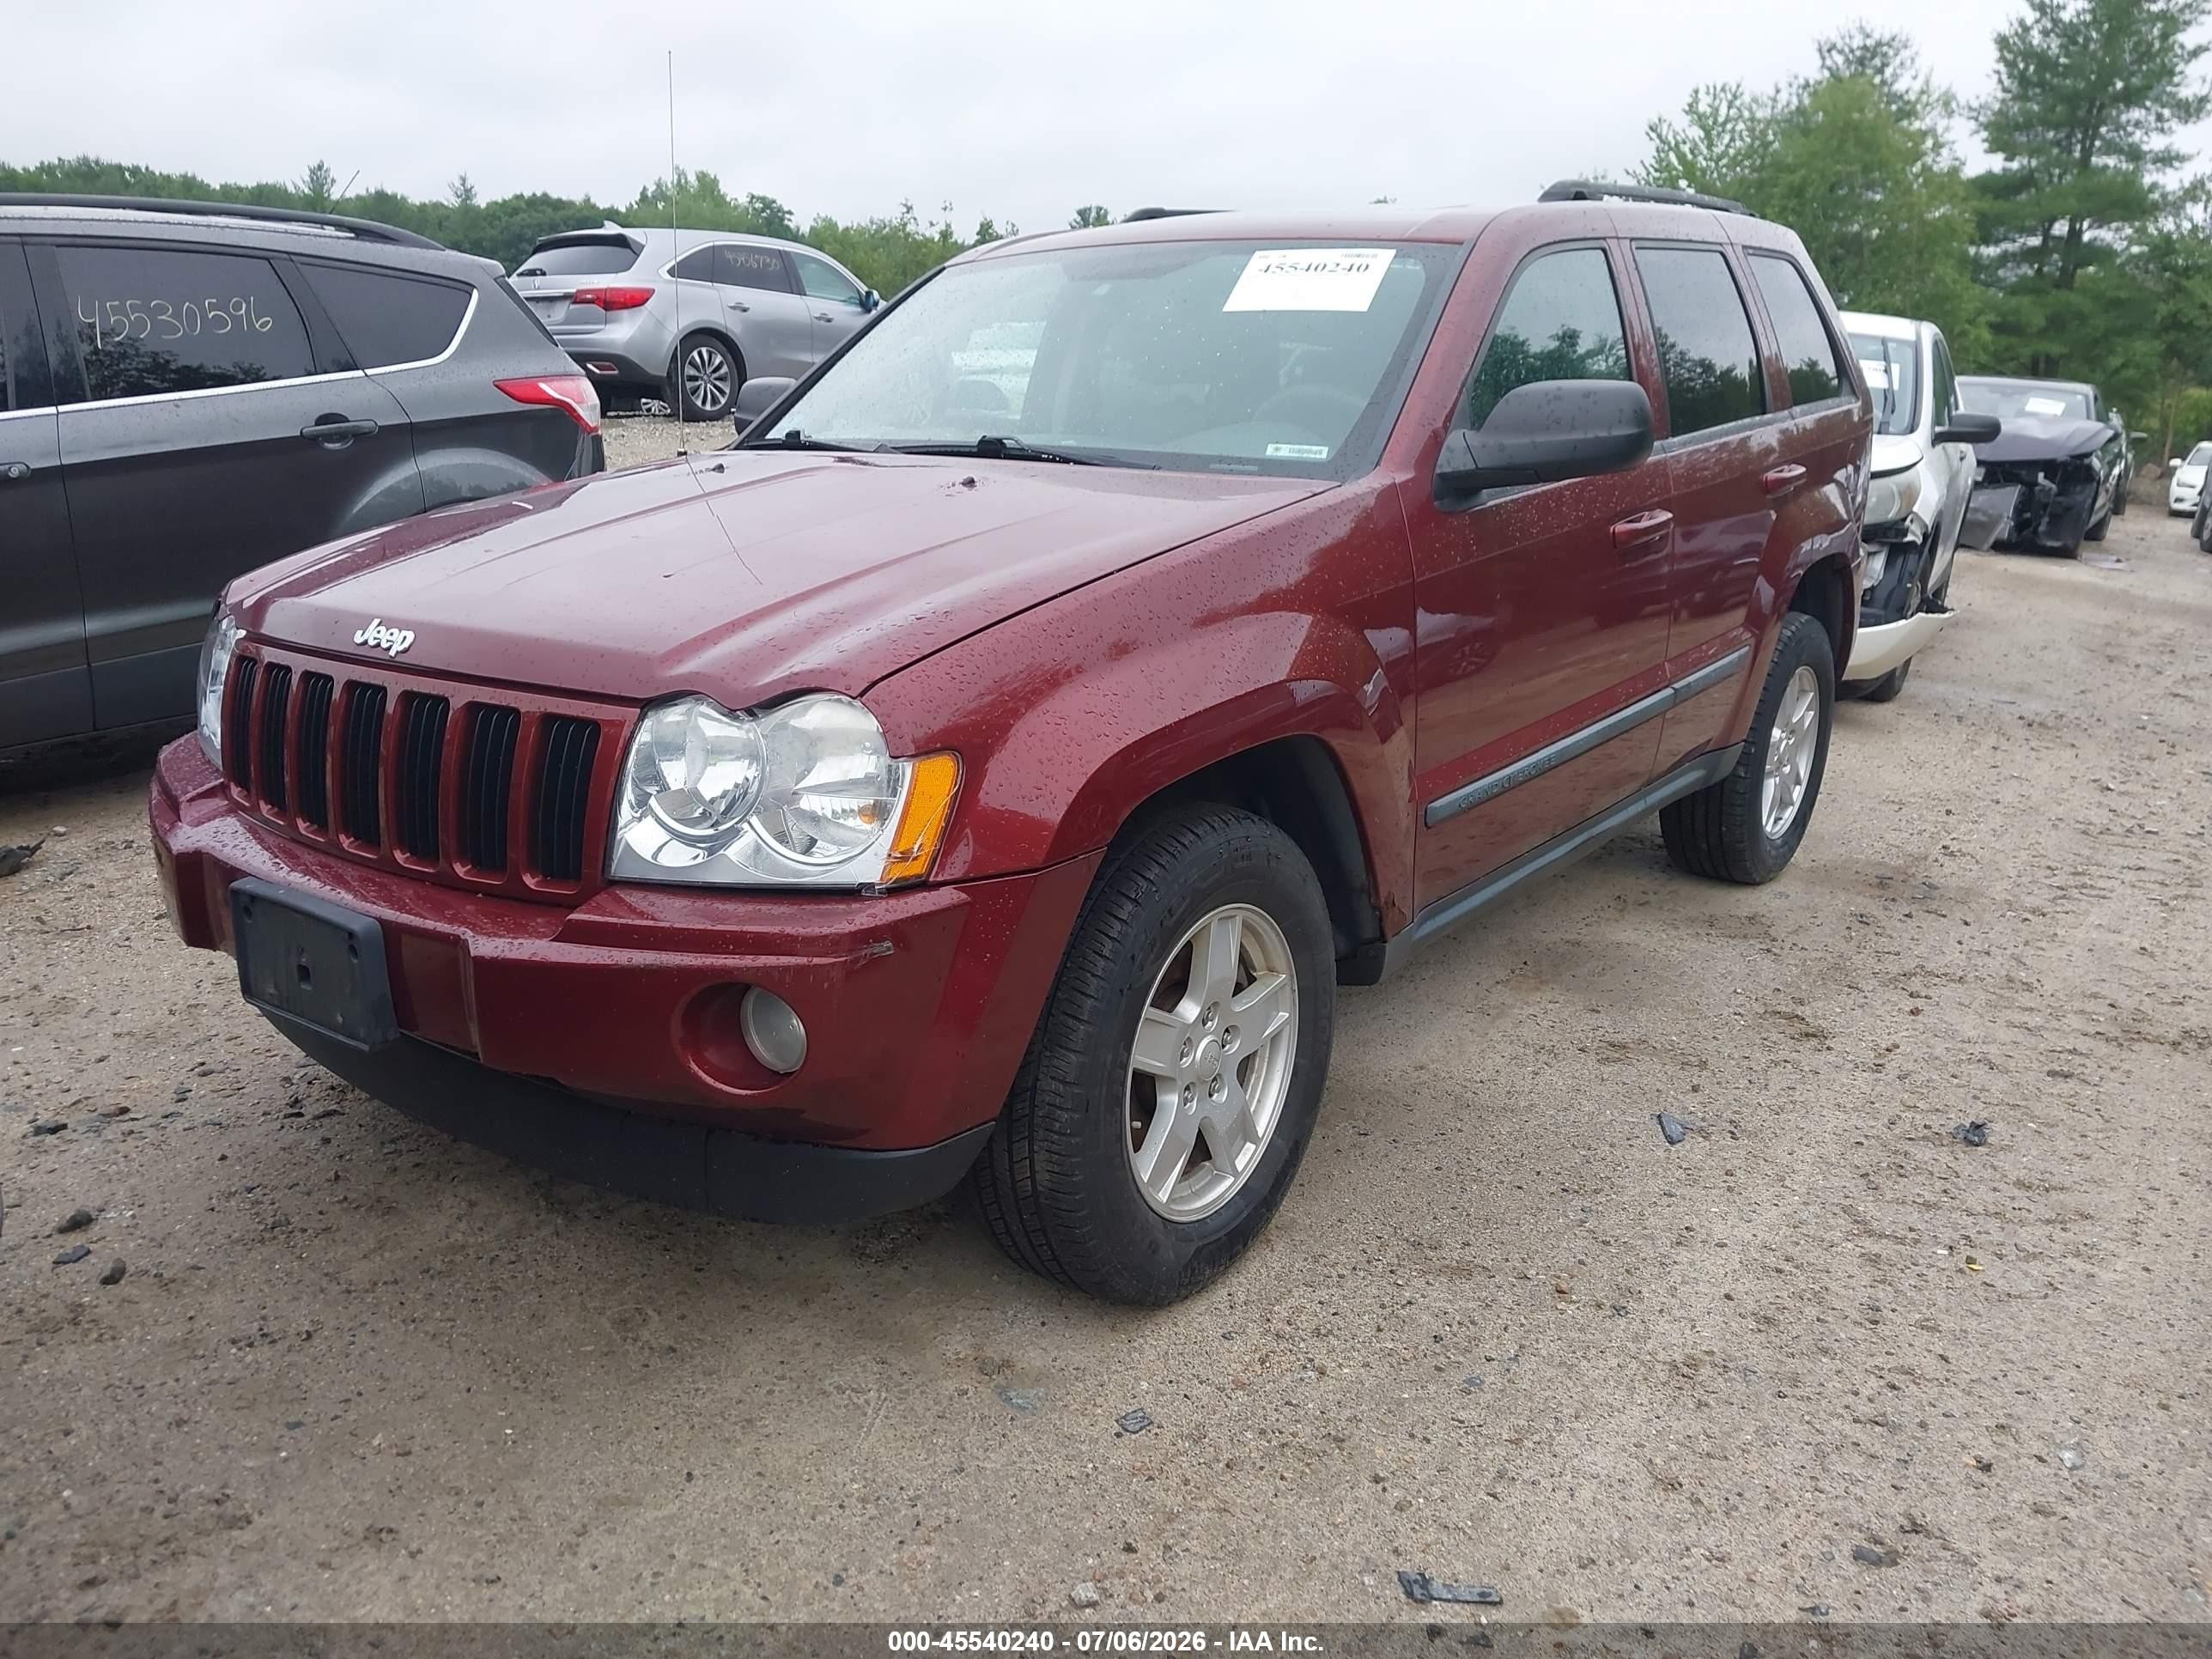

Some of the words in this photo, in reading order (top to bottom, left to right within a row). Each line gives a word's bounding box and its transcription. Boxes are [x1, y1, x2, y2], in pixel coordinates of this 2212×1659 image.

[1258, 262, 1370, 275] 45540240
[77, 295, 273, 350] 45530596
[353, 617, 416, 659] Jeep
[1458, 780, 1499, 810] GRAND
